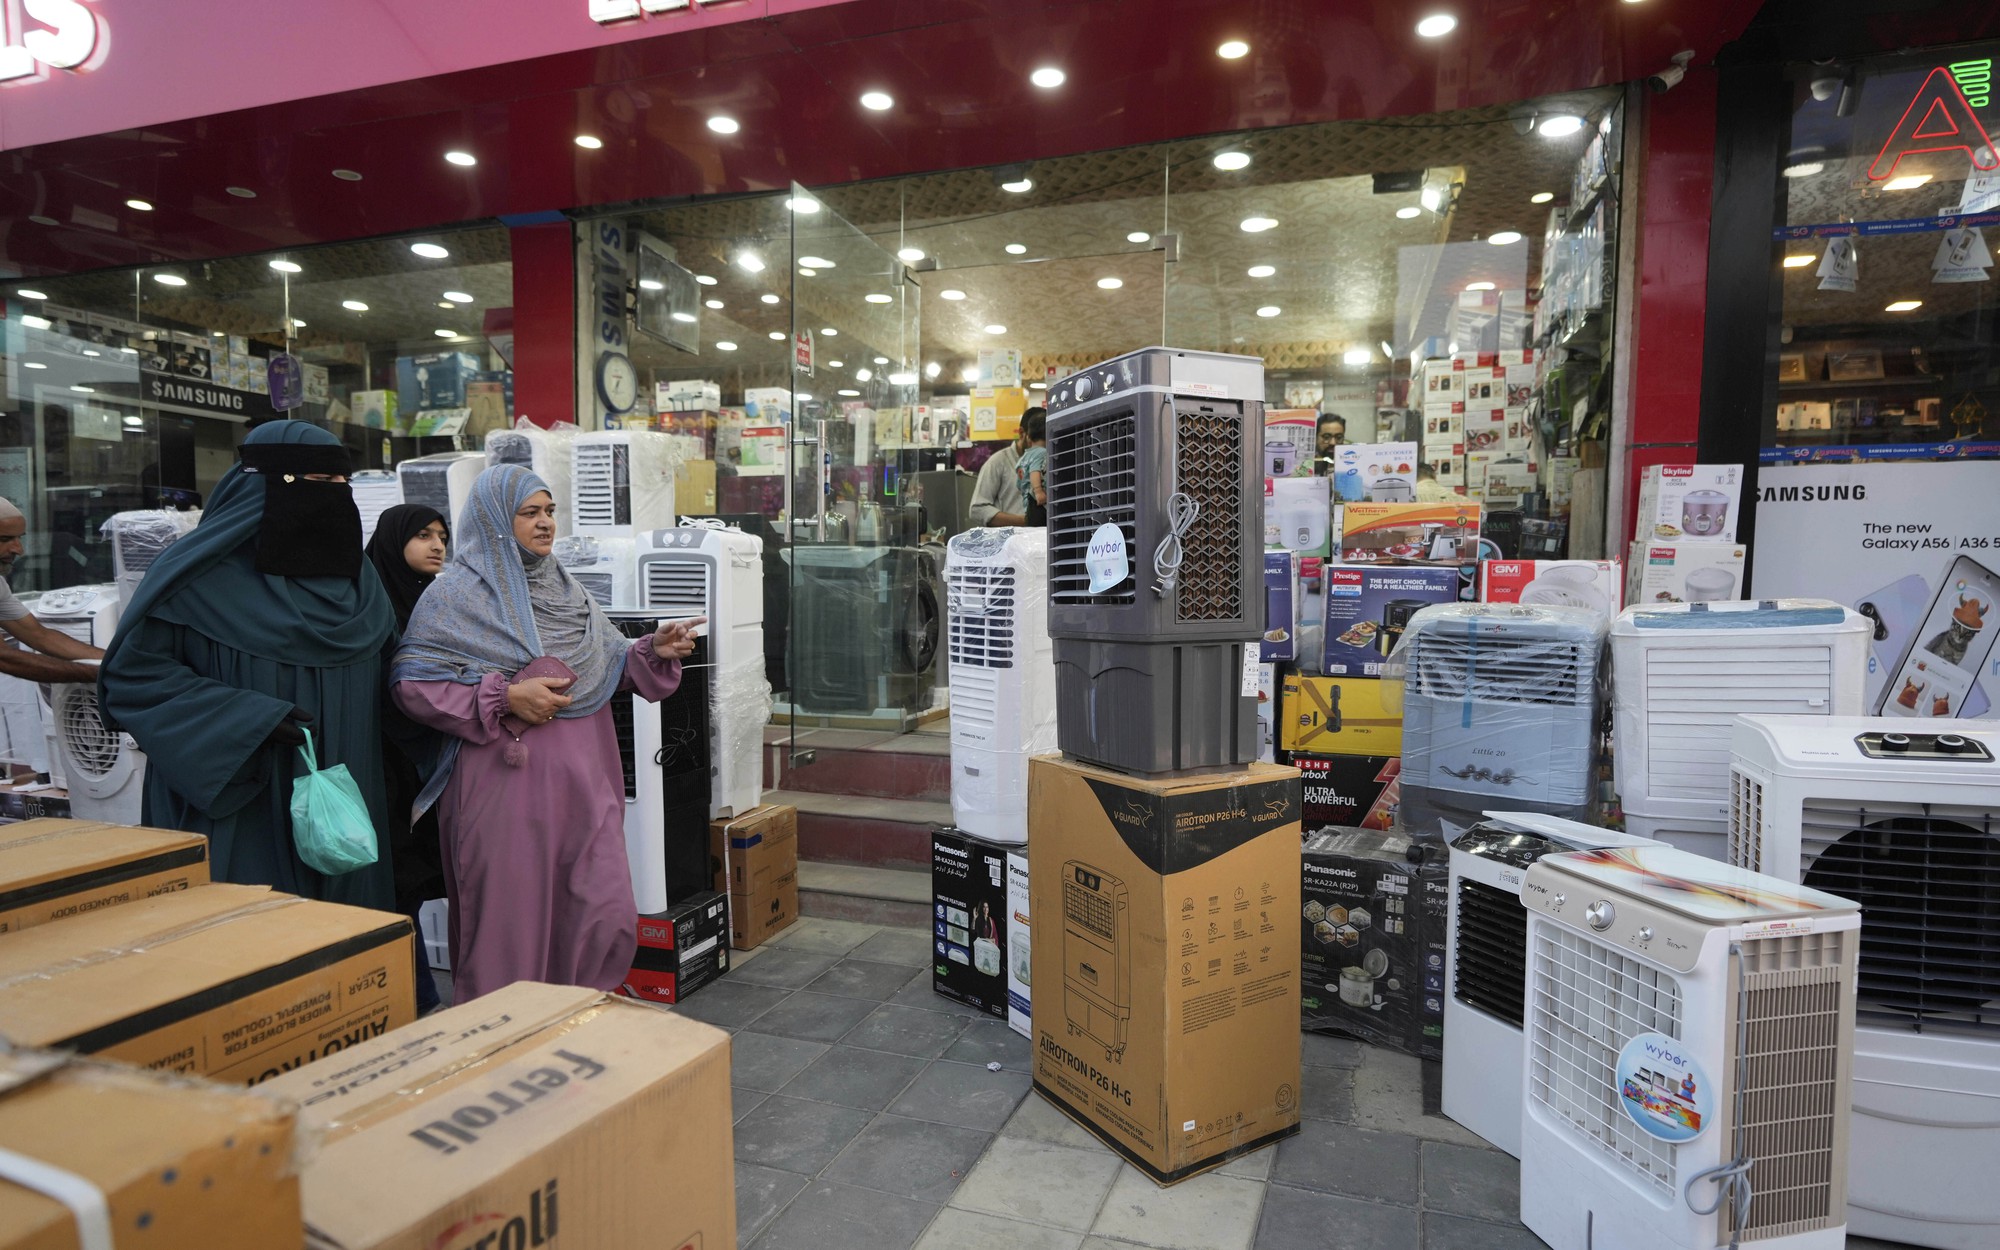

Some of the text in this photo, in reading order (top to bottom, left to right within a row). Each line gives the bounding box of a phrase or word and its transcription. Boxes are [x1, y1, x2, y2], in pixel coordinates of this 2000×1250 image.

[151, 379, 244, 411] SAMSUNG
[1863, 523, 1932, 534] The new
[1862, 537, 1917, 551] Galaxy
[1921, 537, 1950, 549] A56
[1959, 537, 1989, 549] A36
[1333, 571, 1361, 581] Prestige
[1383, 578, 1402, 586] RIGHT
[1868, 657, 1877, 674] e
[1472, 747, 1506, 757] Little 20
[1295, 760, 1330, 770] USHA
[1300, 769, 1329, 780] urboX
[1304, 786, 1336, 797] ULTRA
[1303, 793, 1358, 808] POWERFUL
[26, 802, 46, 817] OTG
[1175, 808, 1247, 828] AIROTRON P26 H-G
[1251, 811, 1279, 823] V-GUARD
[933, 841, 969, 860] Panasonic
[1303, 862, 1358, 879] Panasonic
[1302, 876, 1360, 893] SR-KA22A (R2P)
[1426, 881, 1449, 895] Pan
[50, 891, 131, 921] BALANCED BODY
[678, 919, 695, 934] GM
[765, 911, 786, 930] HAVELLS
[641, 926, 667, 940] GM
[348, 971, 388, 997] 2 YEAR
[222, 990, 333, 1045] POWERFUL COOLING
[224, 1003, 333, 1057] WIDER BLOWER FOR
[449, 1012, 513, 1047] Air
[303, 1046, 438, 1108] Coole
[1039, 1036, 1088, 1078] AIROTRON
[1089, 1066, 1109, 1092] P26
[1111, 1080, 1133, 1107] H-G
[408, 1048, 607, 1156] Ferroli
[452, 1178, 559, 1250] roli
